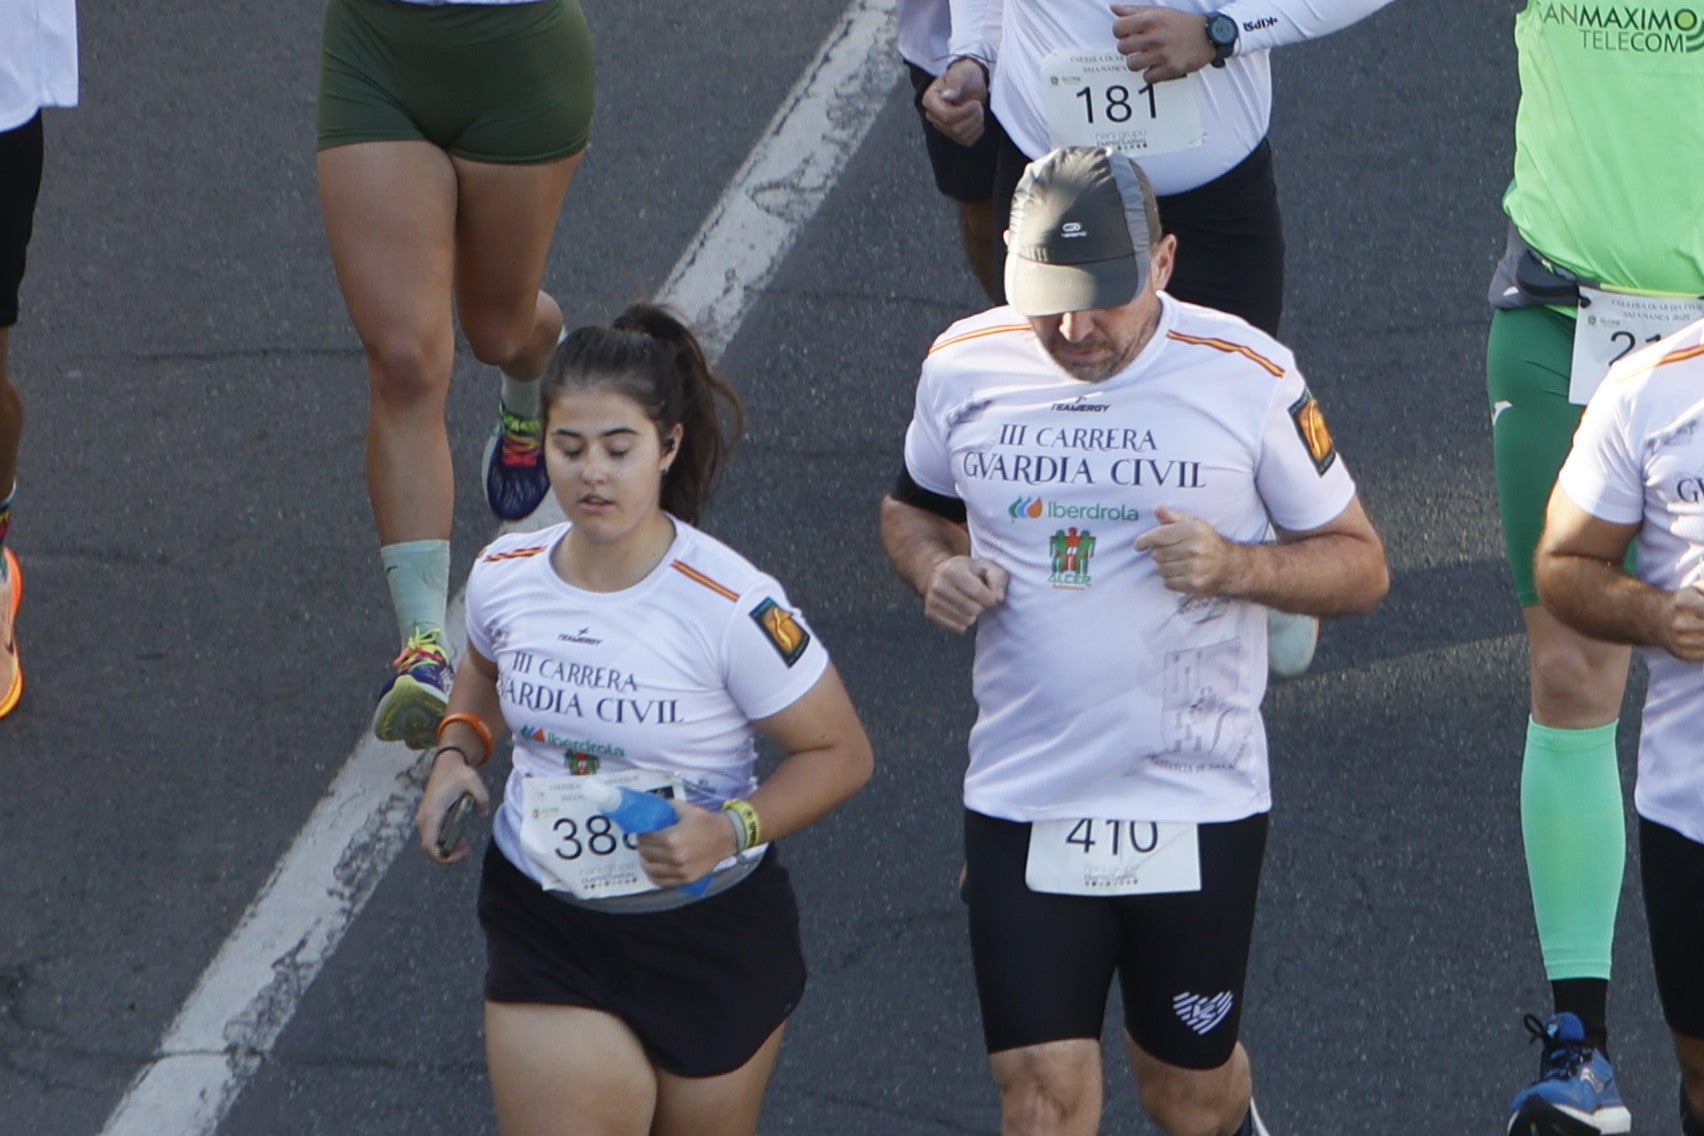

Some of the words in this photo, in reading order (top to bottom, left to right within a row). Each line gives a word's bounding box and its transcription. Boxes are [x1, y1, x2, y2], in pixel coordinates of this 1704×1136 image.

[1579, 29, 1684, 53] TELECOM
[1076, 84, 1157, 124] 181
[998, 424, 1027, 446] III
[1036, 426, 1158, 452] CARRERA
[963, 450, 1095, 486] GVARDIA
[1110, 458, 1207, 489] CIVIL
[512, 651, 533, 674] III
[538, 658, 637, 692] CARRERA
[596, 697, 685, 725] CIVIL
[1066, 817, 1158, 855] 410
